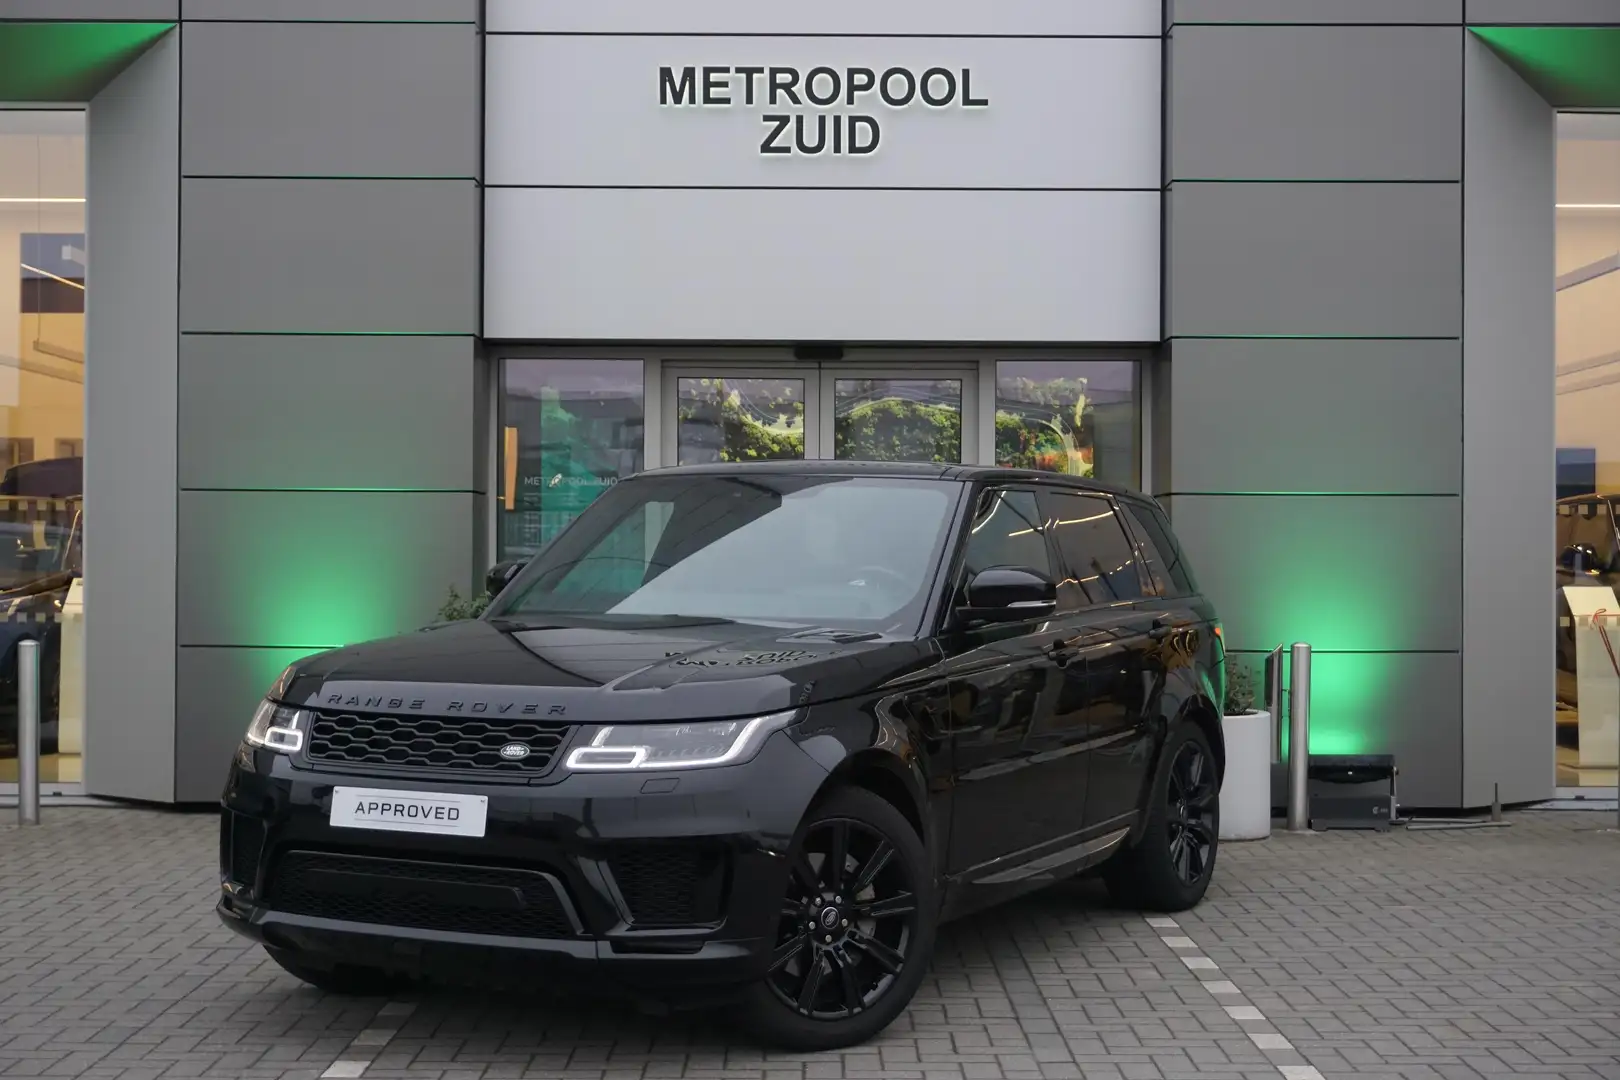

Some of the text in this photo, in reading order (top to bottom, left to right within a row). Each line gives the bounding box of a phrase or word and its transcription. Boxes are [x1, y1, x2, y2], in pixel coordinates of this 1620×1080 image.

[659, 66, 989, 107] METROPOOL
[760, 114, 881, 155] ZUID
[524, 476, 593, 487] METRPOOL
[327, 694, 567, 716] RANGE ROVER
[354, 801, 460, 821] APPROVED
